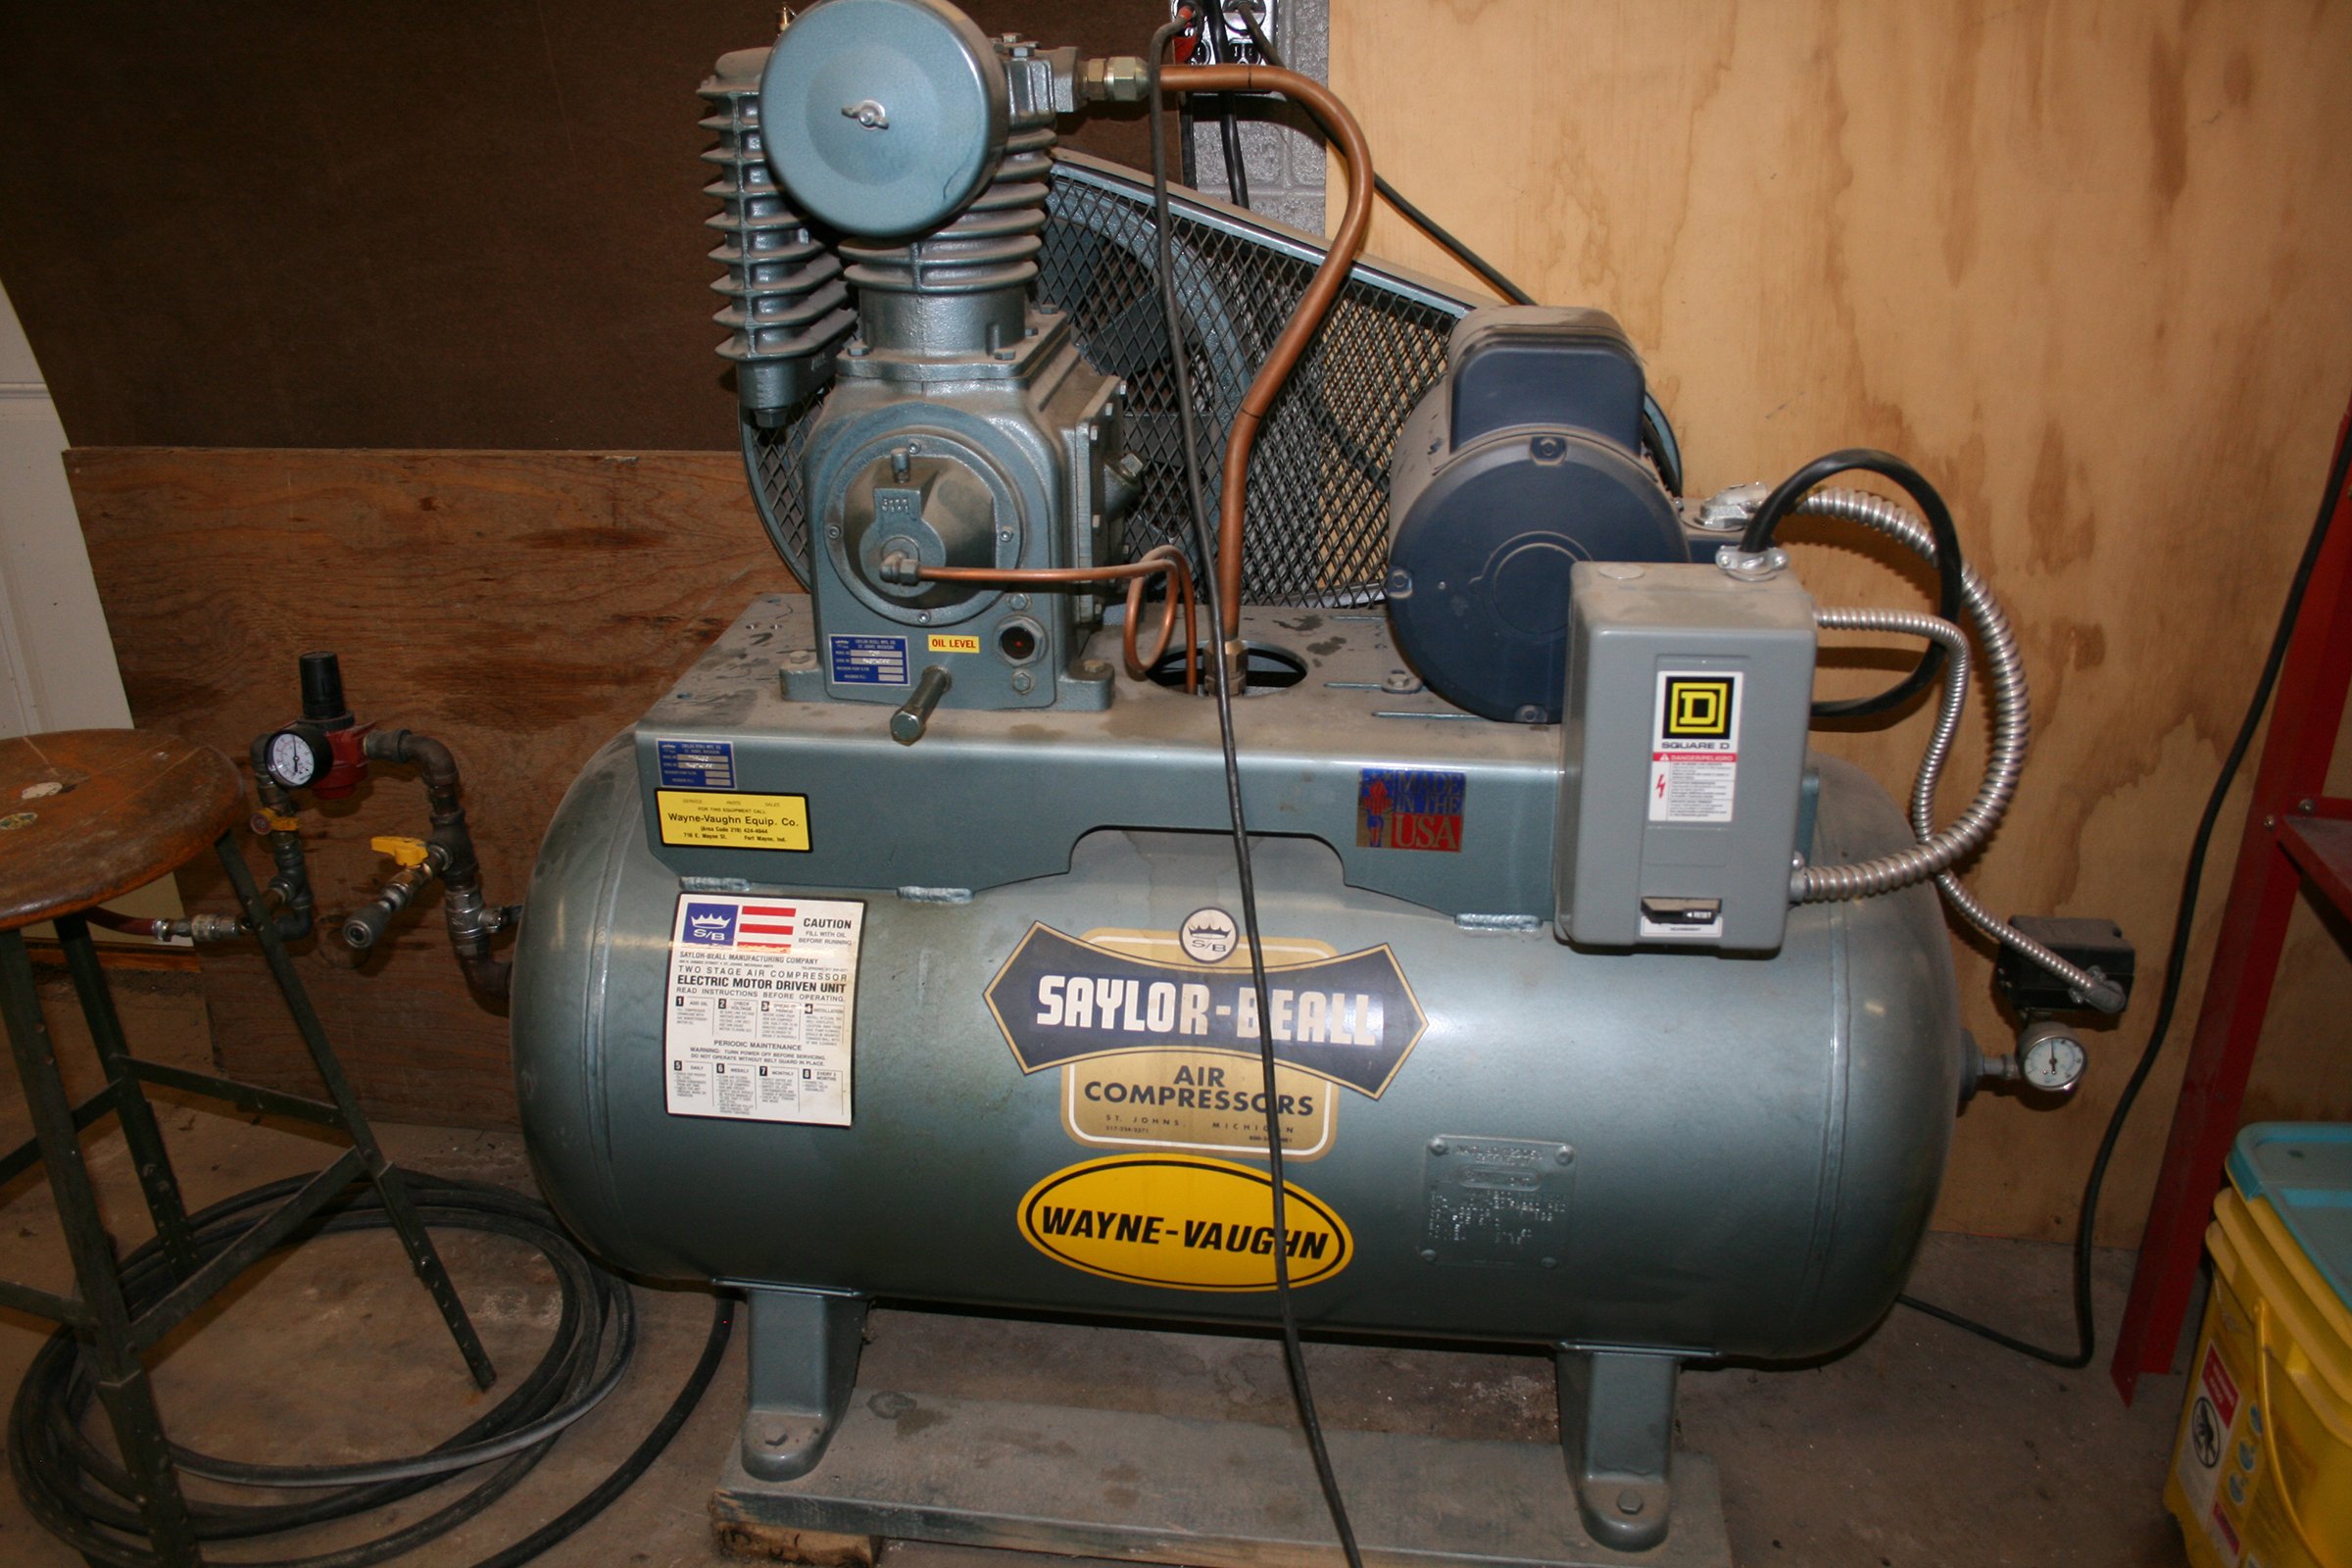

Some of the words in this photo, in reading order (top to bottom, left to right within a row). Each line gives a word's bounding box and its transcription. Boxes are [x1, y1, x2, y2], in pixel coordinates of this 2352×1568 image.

[949, 639, 976, 648] LEVEL
[1397, 772, 1458, 795] MADE
[668, 812, 741, 825] Wayne-Vaughn
[745, 816, 777, 827] Equip.
[782, 817, 799, 826] Co.
[1396, 814, 1458, 849] USA
[804, 917, 852, 929] CAUTION
[694, 929, 725, 941] S/B
[1192, 940, 1226, 952] S/B
[680, 951, 726, 960] SAYLOR-BEALL
[729, 954, 784, 963] MANUFACTURING
[707, 966, 741, 975] STAGE
[770, 970, 847, 982] COMPRESSOR
[678, 975, 729, 987] ELECTRIC
[733, 978, 772, 989] MOTOR
[776, 980, 816, 992] DRIVEN
[820, 983, 846, 993] UNIT
[702, 988, 758, 997] INSTRUCTIONS
[1037, 974, 1376, 1046] SAYLOR-BEALL
[1174, 1065, 1225, 1088] AIR
[1084, 1082, 1314, 1116] COMPRESSORS
[1133, 1117, 1186, 1127] JOHNS,
[1212, 1122, 1293, 1133] MICHIGN
[1042, 1205, 1329, 1259] WAYNE-VAUGHN
